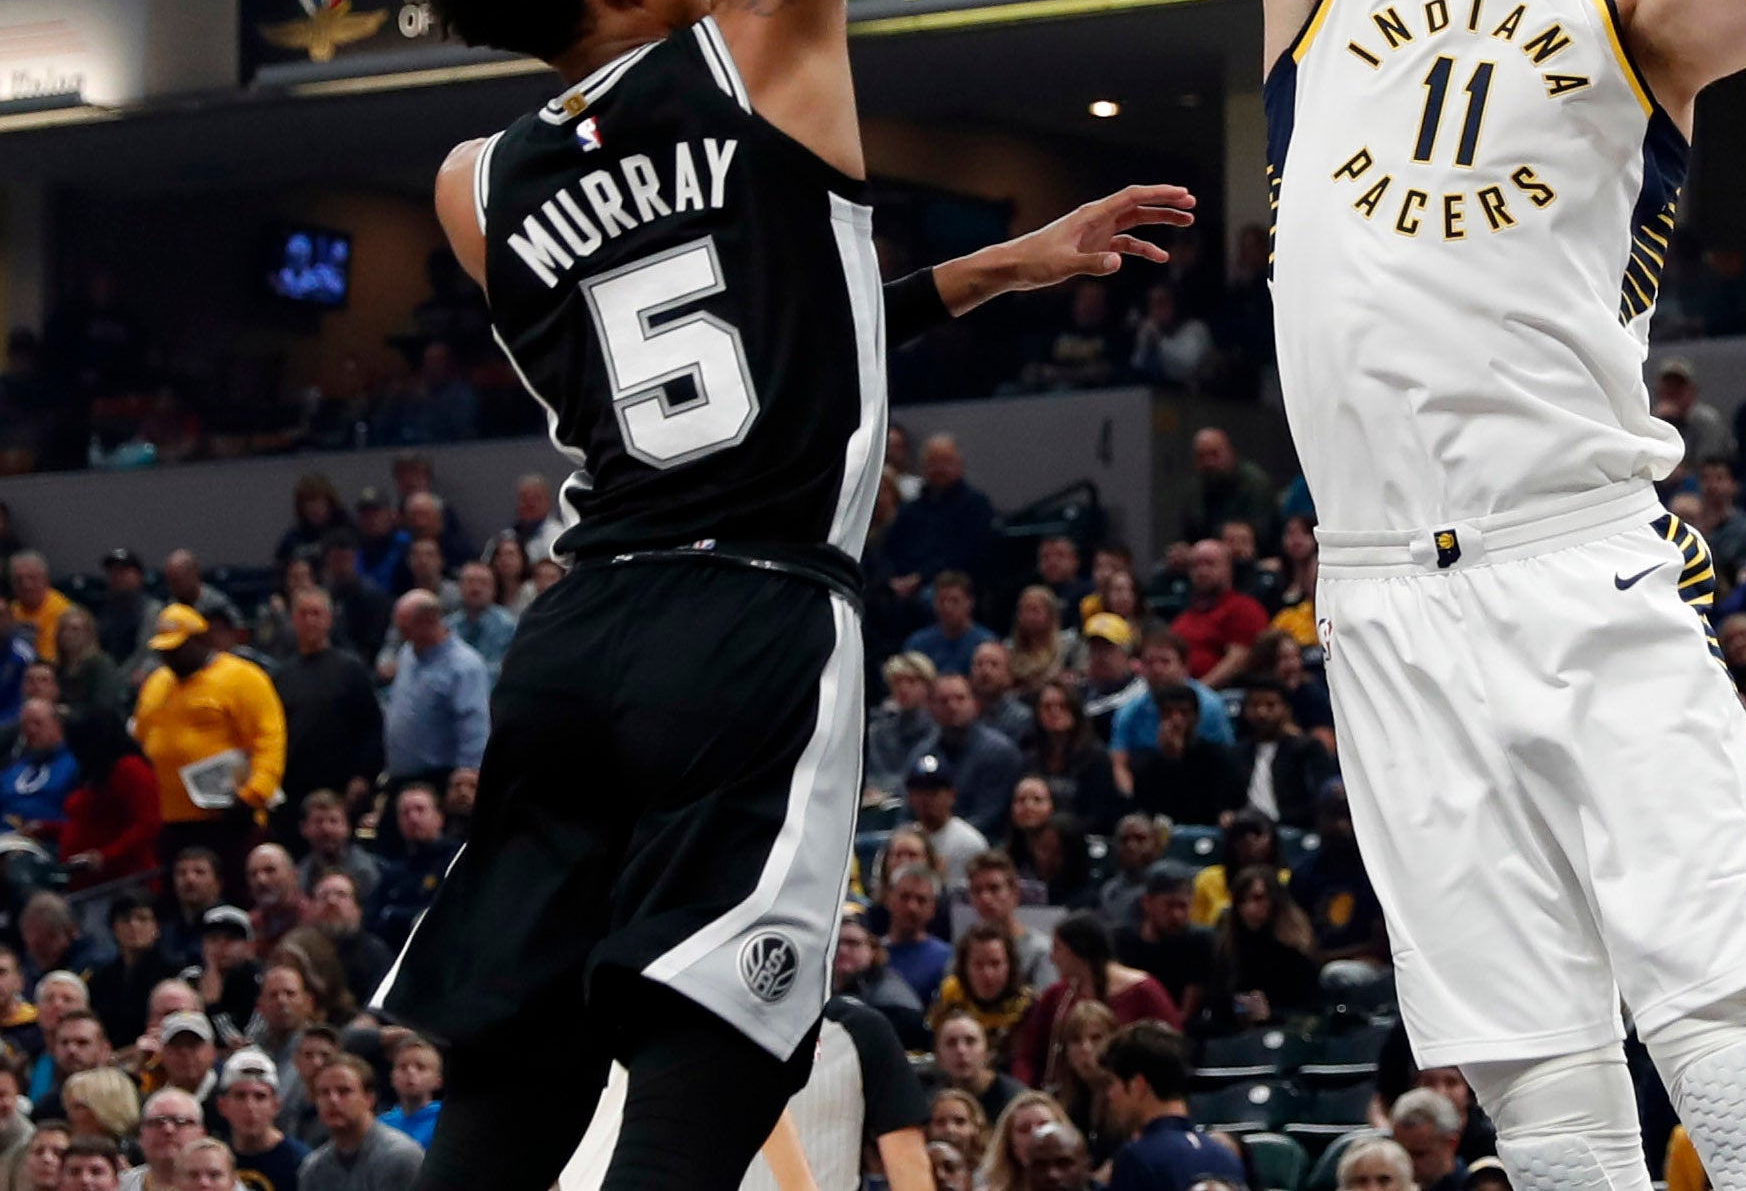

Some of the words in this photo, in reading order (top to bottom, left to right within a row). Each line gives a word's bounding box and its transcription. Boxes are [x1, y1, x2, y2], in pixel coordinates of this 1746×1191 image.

[1409, 52, 1498, 169] 11
[507, 137, 738, 289] MURRAY
[1331, 145, 1558, 243] PACERS
[578, 233, 760, 470] 5
